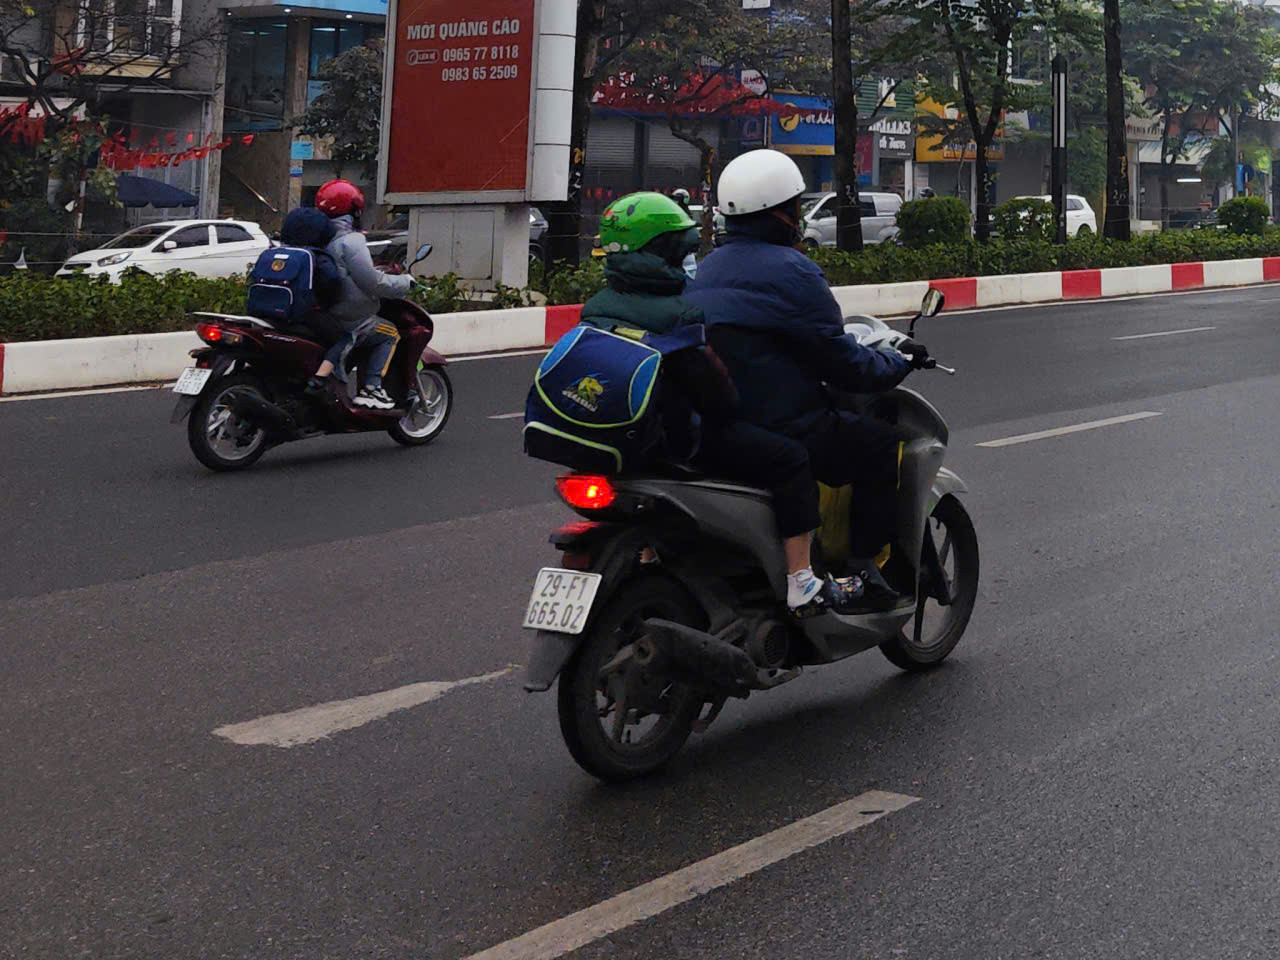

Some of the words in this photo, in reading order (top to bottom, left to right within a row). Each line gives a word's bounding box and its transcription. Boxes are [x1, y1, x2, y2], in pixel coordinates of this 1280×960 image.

[439, 17, 488, 41] QUẢNG
[492, 16, 520, 35] CÁO
[443, 48, 471, 62] 0965
[473, 46, 488, 61] 77
[490, 44, 519, 60] 8118
[441, 67, 469, 82] 0983
[472, 66, 487, 80] 65
[489, 64, 518, 80] 2509
[540, 573, 589, 601] 29-F1
[527, 601, 585, 630] 665.02
